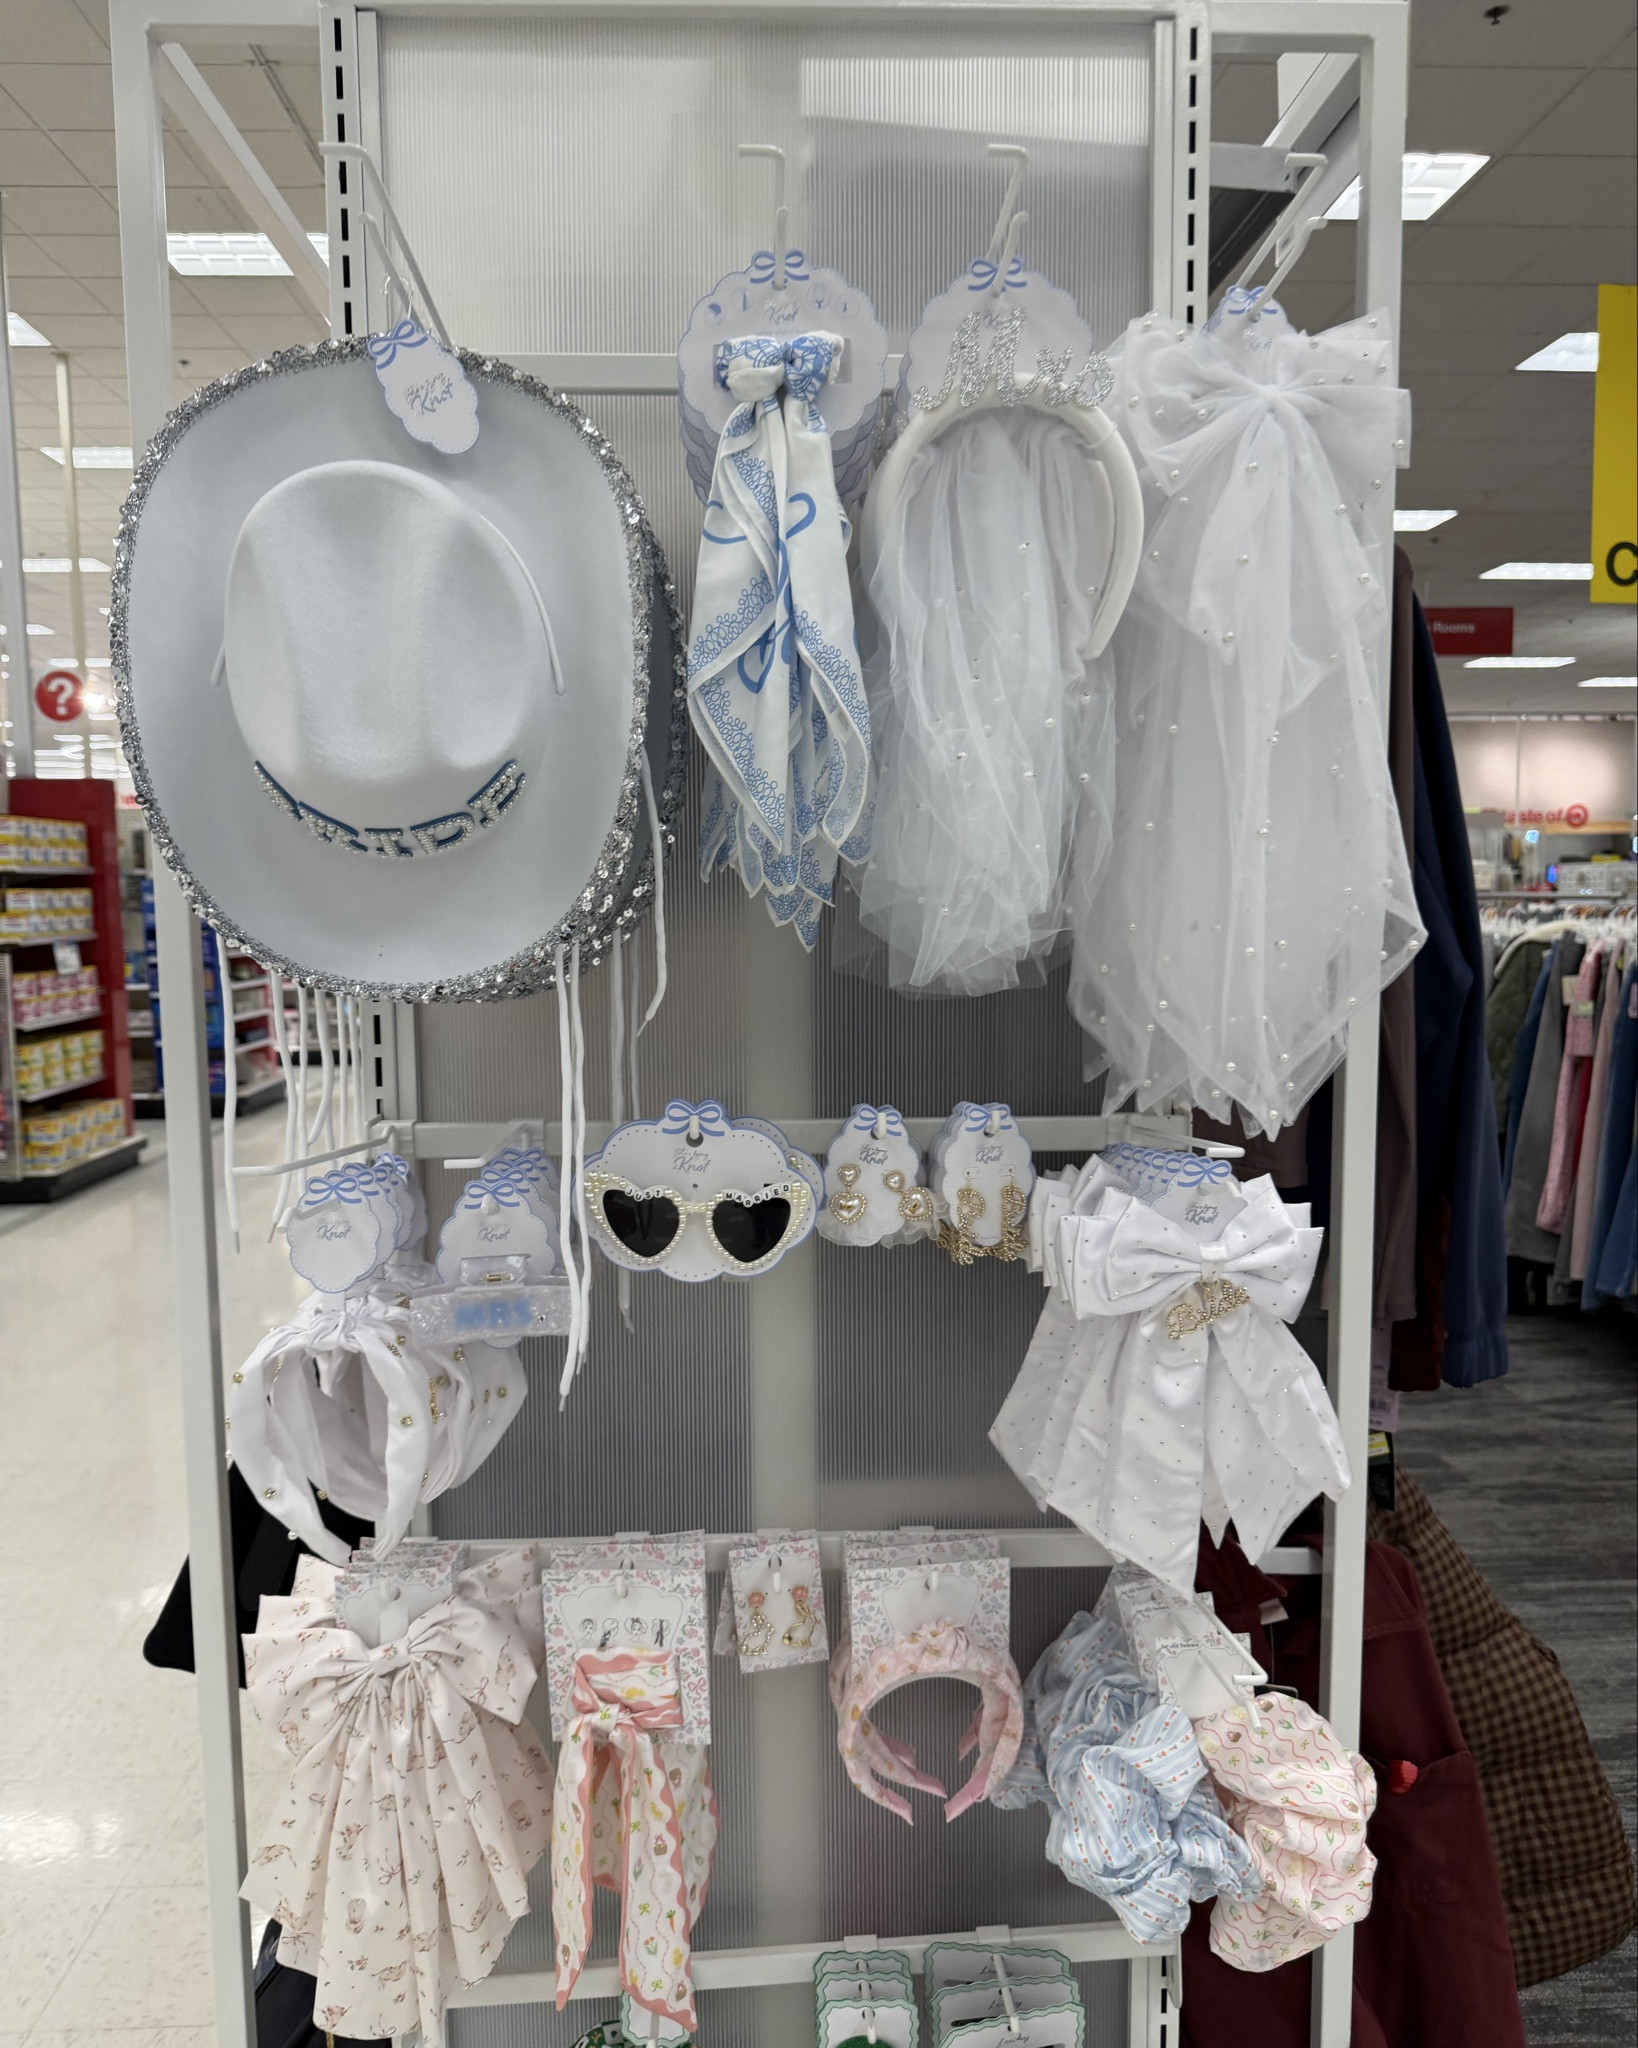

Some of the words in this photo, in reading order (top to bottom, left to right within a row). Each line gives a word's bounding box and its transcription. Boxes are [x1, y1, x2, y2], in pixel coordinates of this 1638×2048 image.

[914, 308, 1115, 408] Mrs
[411, 378, 453, 414] Knot
[1433, 621, 1476, 633] Rooms
[1504, 809, 1543, 824] aste
[1546, 807, 1563, 823] of
[674, 1156, 712, 1174] Knot
[859, 1150, 889, 1165] Knot
[626, 1188, 663, 1201] JUST
[725, 1183, 790, 1206] MARRIED
[1186, 1209, 1219, 1225] Knot
[317, 1223, 352, 1242] Knot
[479, 1226, 511, 1243] Knot
[454, 1297, 533, 1330] MRS
[1165, 1279, 1250, 1339] Bride
[979, 1966, 1014, 1978] Luy
[988, 2000, 1022, 2011] Luy
[996, 2033, 1030, 2048] Lucky
